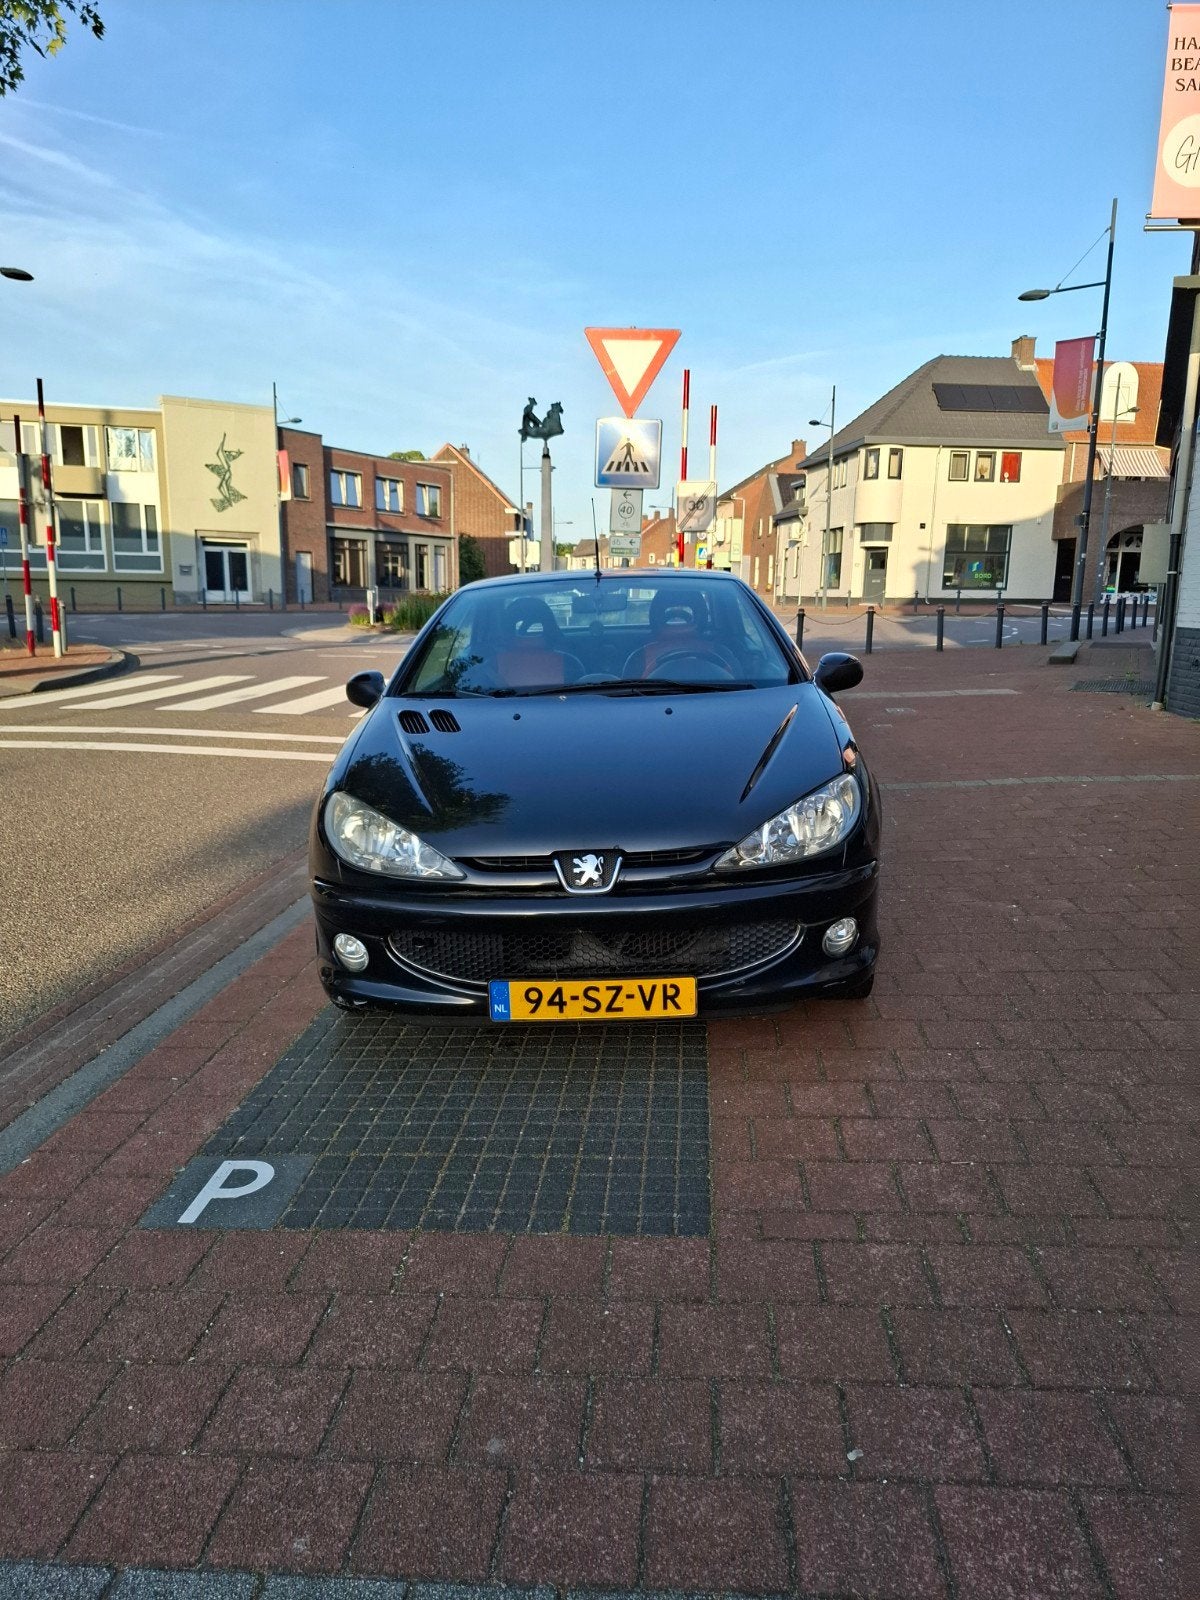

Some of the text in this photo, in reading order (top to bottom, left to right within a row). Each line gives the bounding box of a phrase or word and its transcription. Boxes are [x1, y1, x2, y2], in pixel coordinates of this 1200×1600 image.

[1174, 36, 1200, 50] HA
[1175, 78, 1200, 92] SA
[619, 506, 633, 515] 40
[689, 500, 705, 511] 30
[524, 983, 682, 1014] 94-SZ-VR
[494, 1004, 507, 1013] NL
[177, 1160, 275, 1224] P
